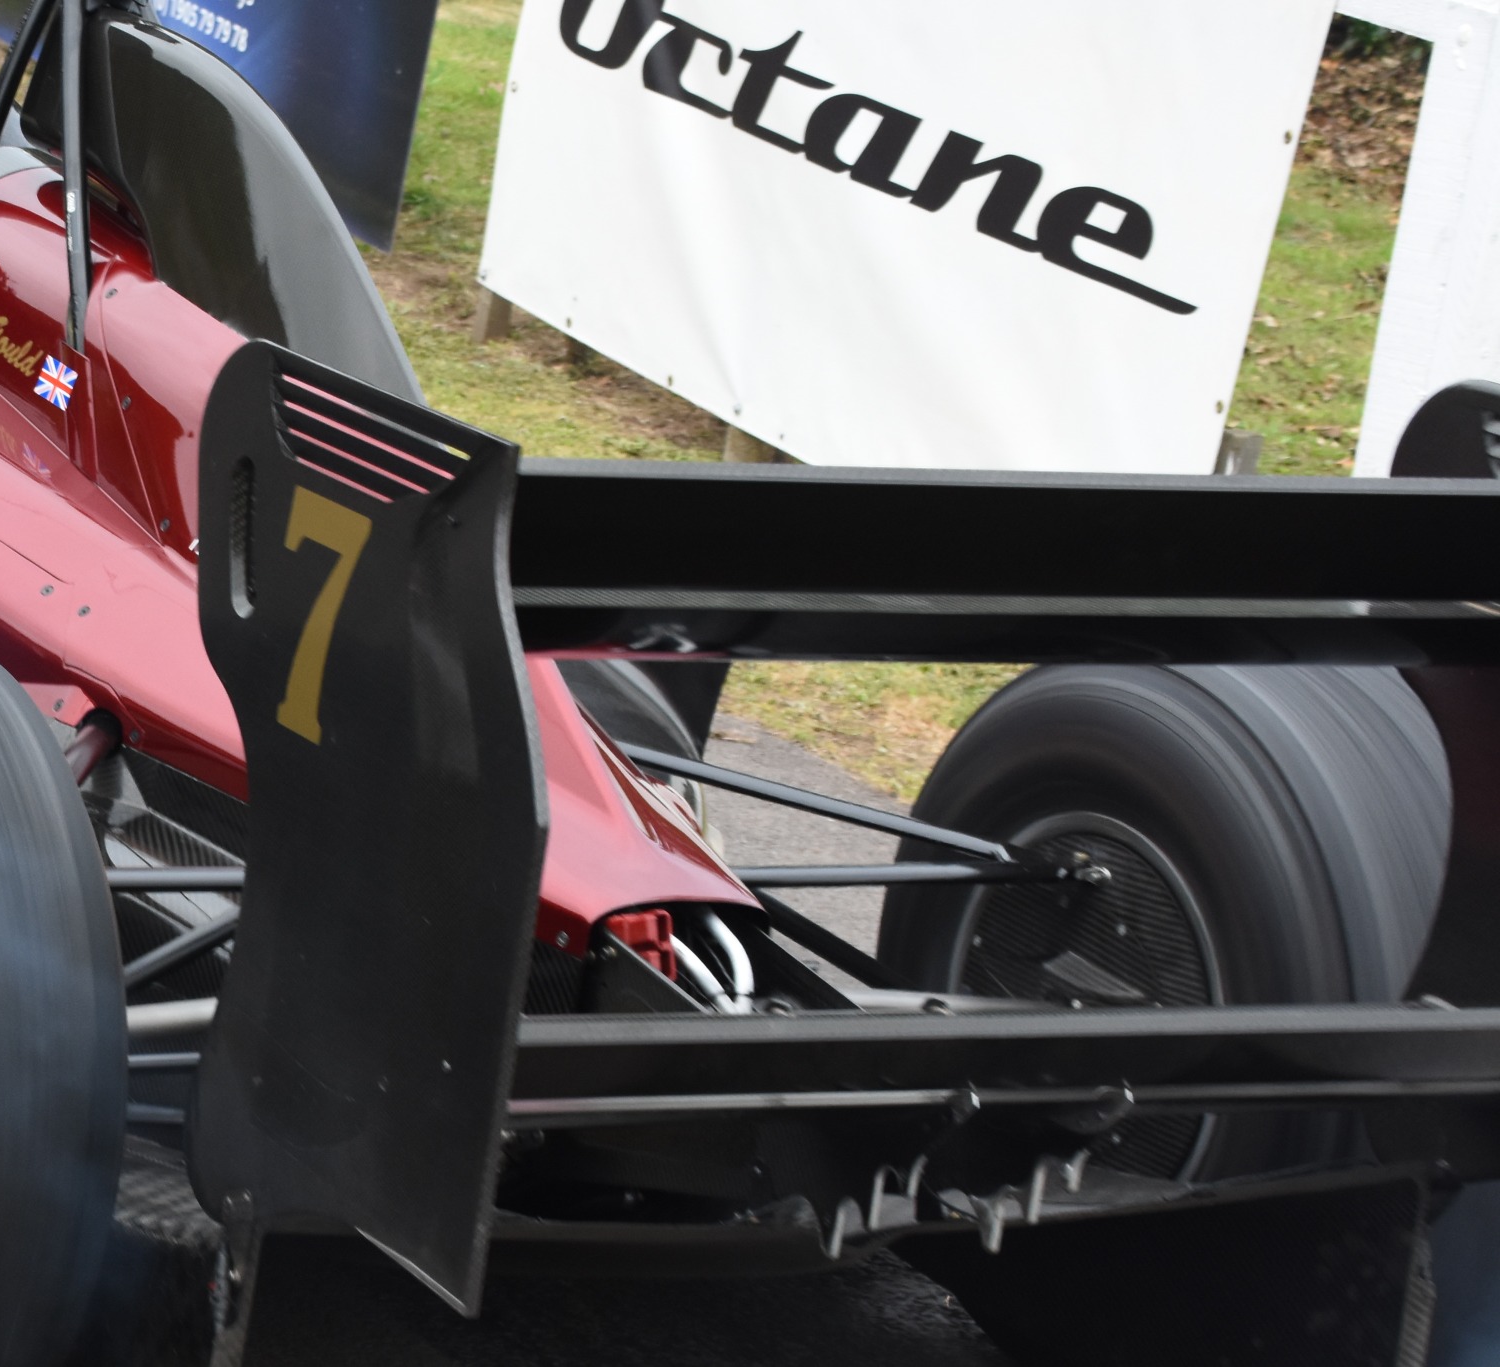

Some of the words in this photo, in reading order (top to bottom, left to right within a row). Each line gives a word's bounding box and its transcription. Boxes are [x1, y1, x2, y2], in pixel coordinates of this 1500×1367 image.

[197, 8, 215, 36] 79
[214, 16, 232, 44] 79
[230, 24, 249, 53] 78
[559, 0, 1198, 315] Octane
[276, 484, 373, 746] 7
